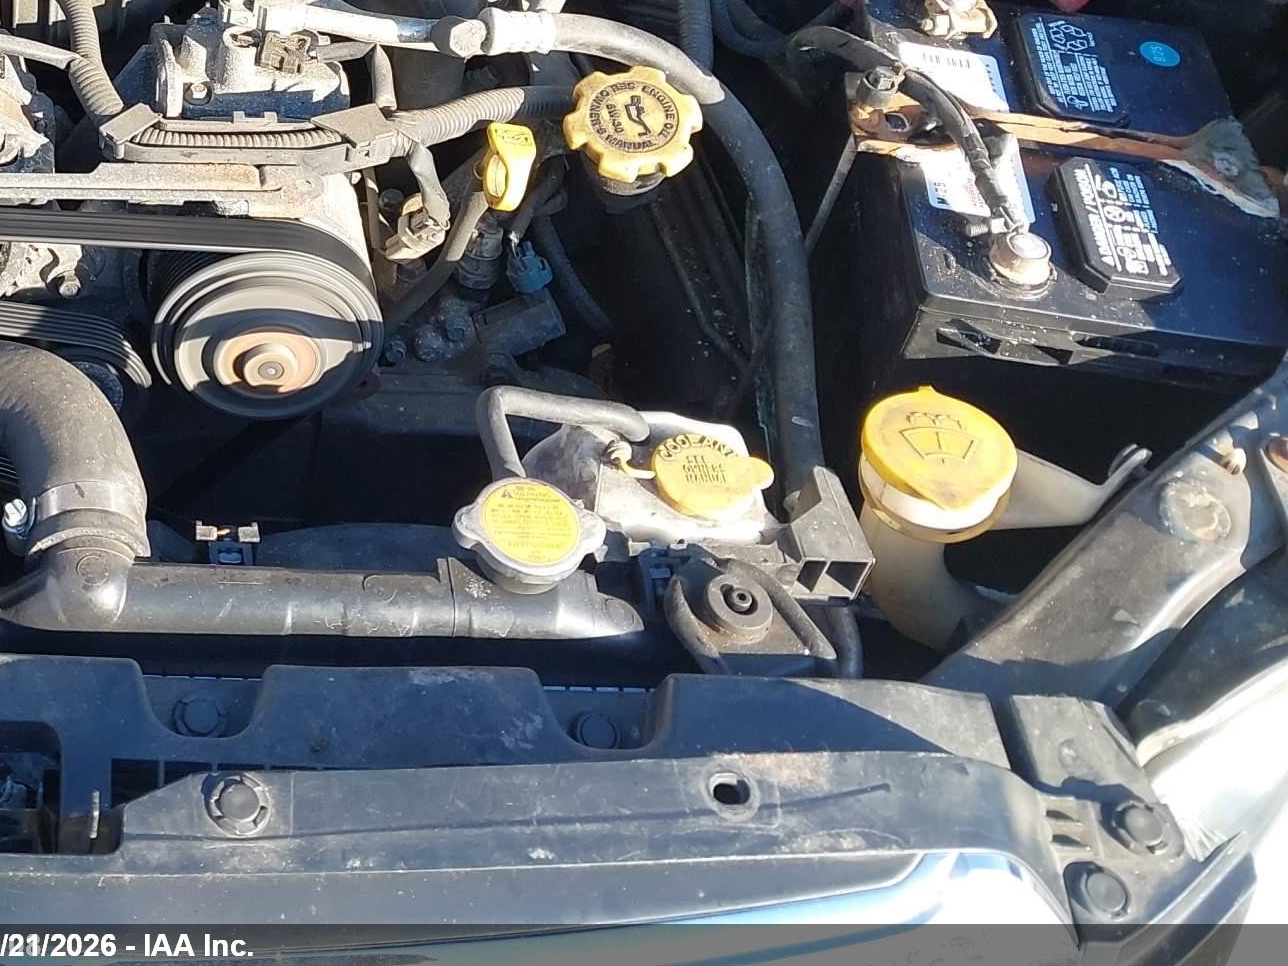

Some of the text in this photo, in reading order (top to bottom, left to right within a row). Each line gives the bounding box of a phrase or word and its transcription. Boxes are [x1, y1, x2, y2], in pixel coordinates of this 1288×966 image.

[641, 85, 676, 138] ENGINE OIL
[605, 134, 657, 150] MANUAL
[658, 434, 737, 462] COOLANT
[685, 473, 727, 483] MANUA
